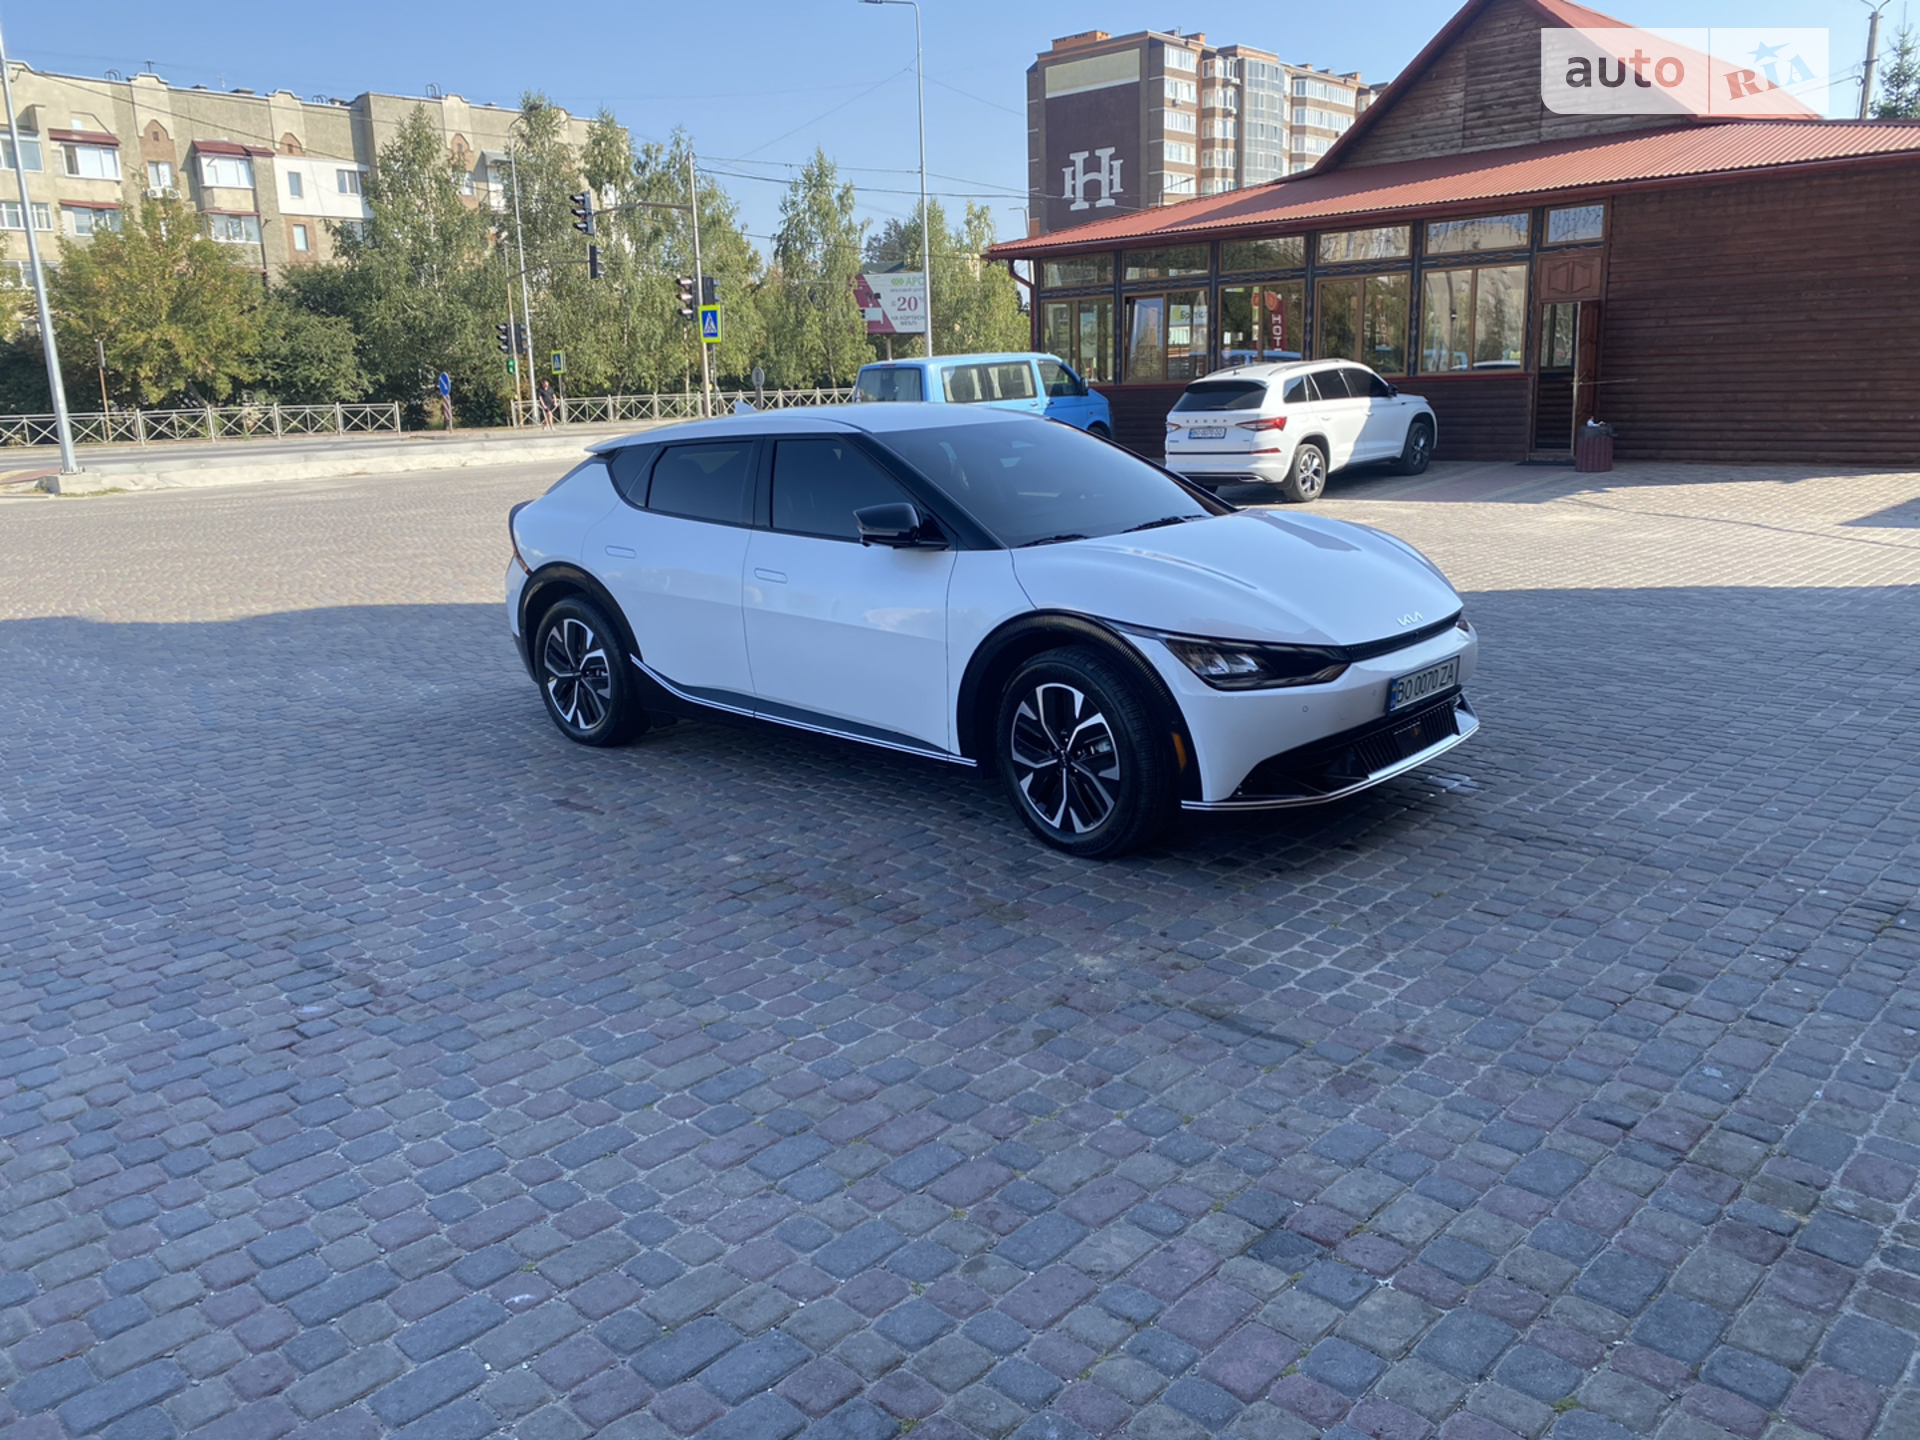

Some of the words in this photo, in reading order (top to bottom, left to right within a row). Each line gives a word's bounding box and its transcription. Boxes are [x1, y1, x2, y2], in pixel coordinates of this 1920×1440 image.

[1397, 679, 1413, 703] BO
[1414, 669, 1439, 697] 0070
[1440, 663, 1454, 687] ZA
